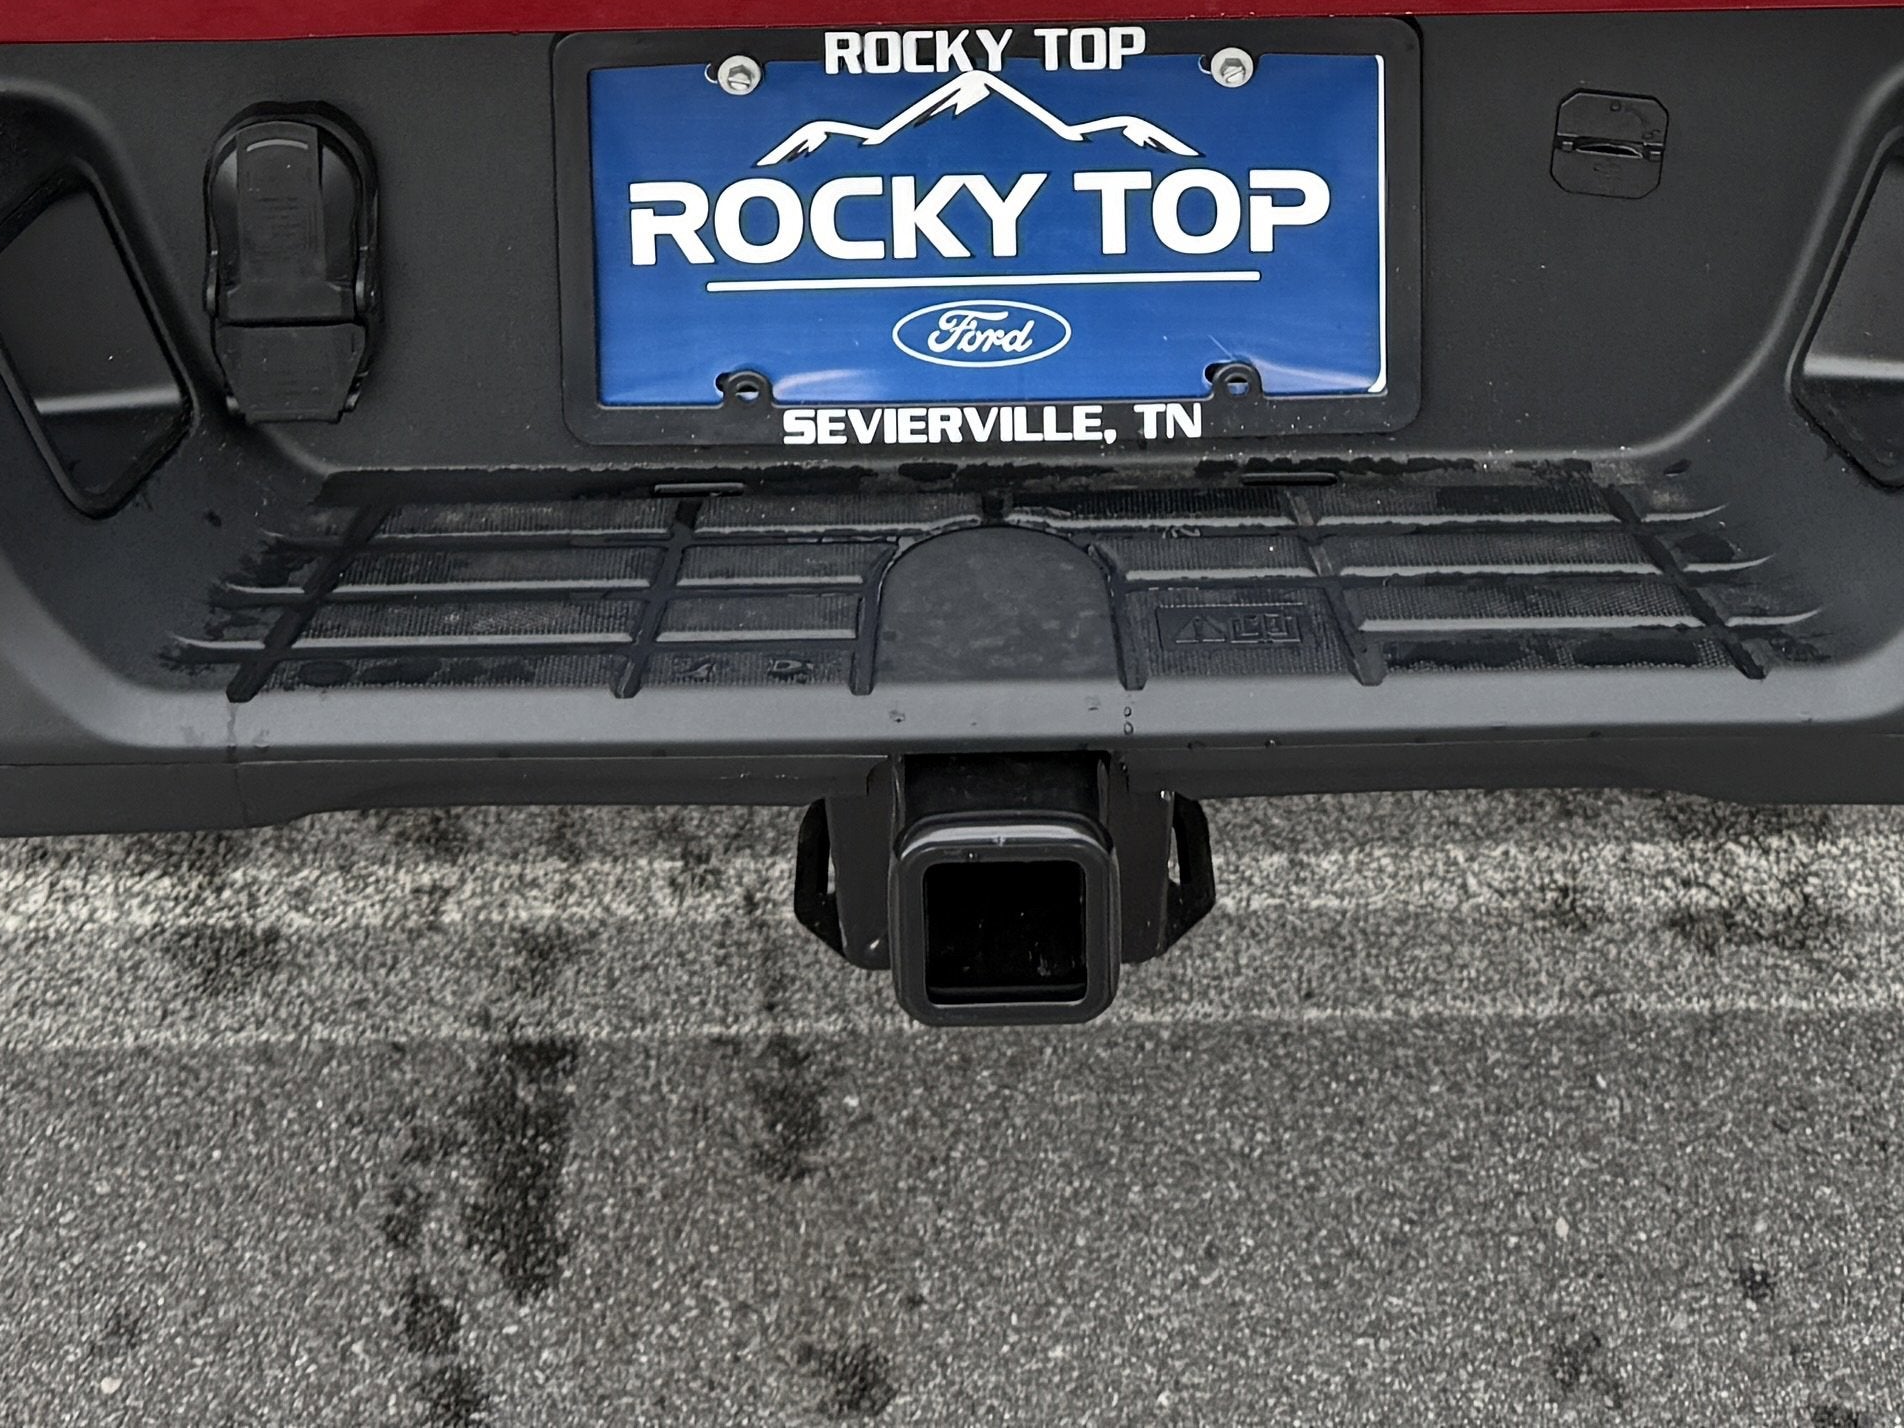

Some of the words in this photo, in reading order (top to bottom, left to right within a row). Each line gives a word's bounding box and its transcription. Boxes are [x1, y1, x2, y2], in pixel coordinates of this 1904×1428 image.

[825, 28, 1012, 74] ROCKY
[1034, 26, 1145, 71] TOP
[630, 174, 1047, 265] ROCKY
[1074, 169, 1330, 254] TOP
[928, 309, 1034, 353] Ford
[784, 406, 1117, 445] SEVIERVILLE,
[1134, 403, 1202, 439] TN
